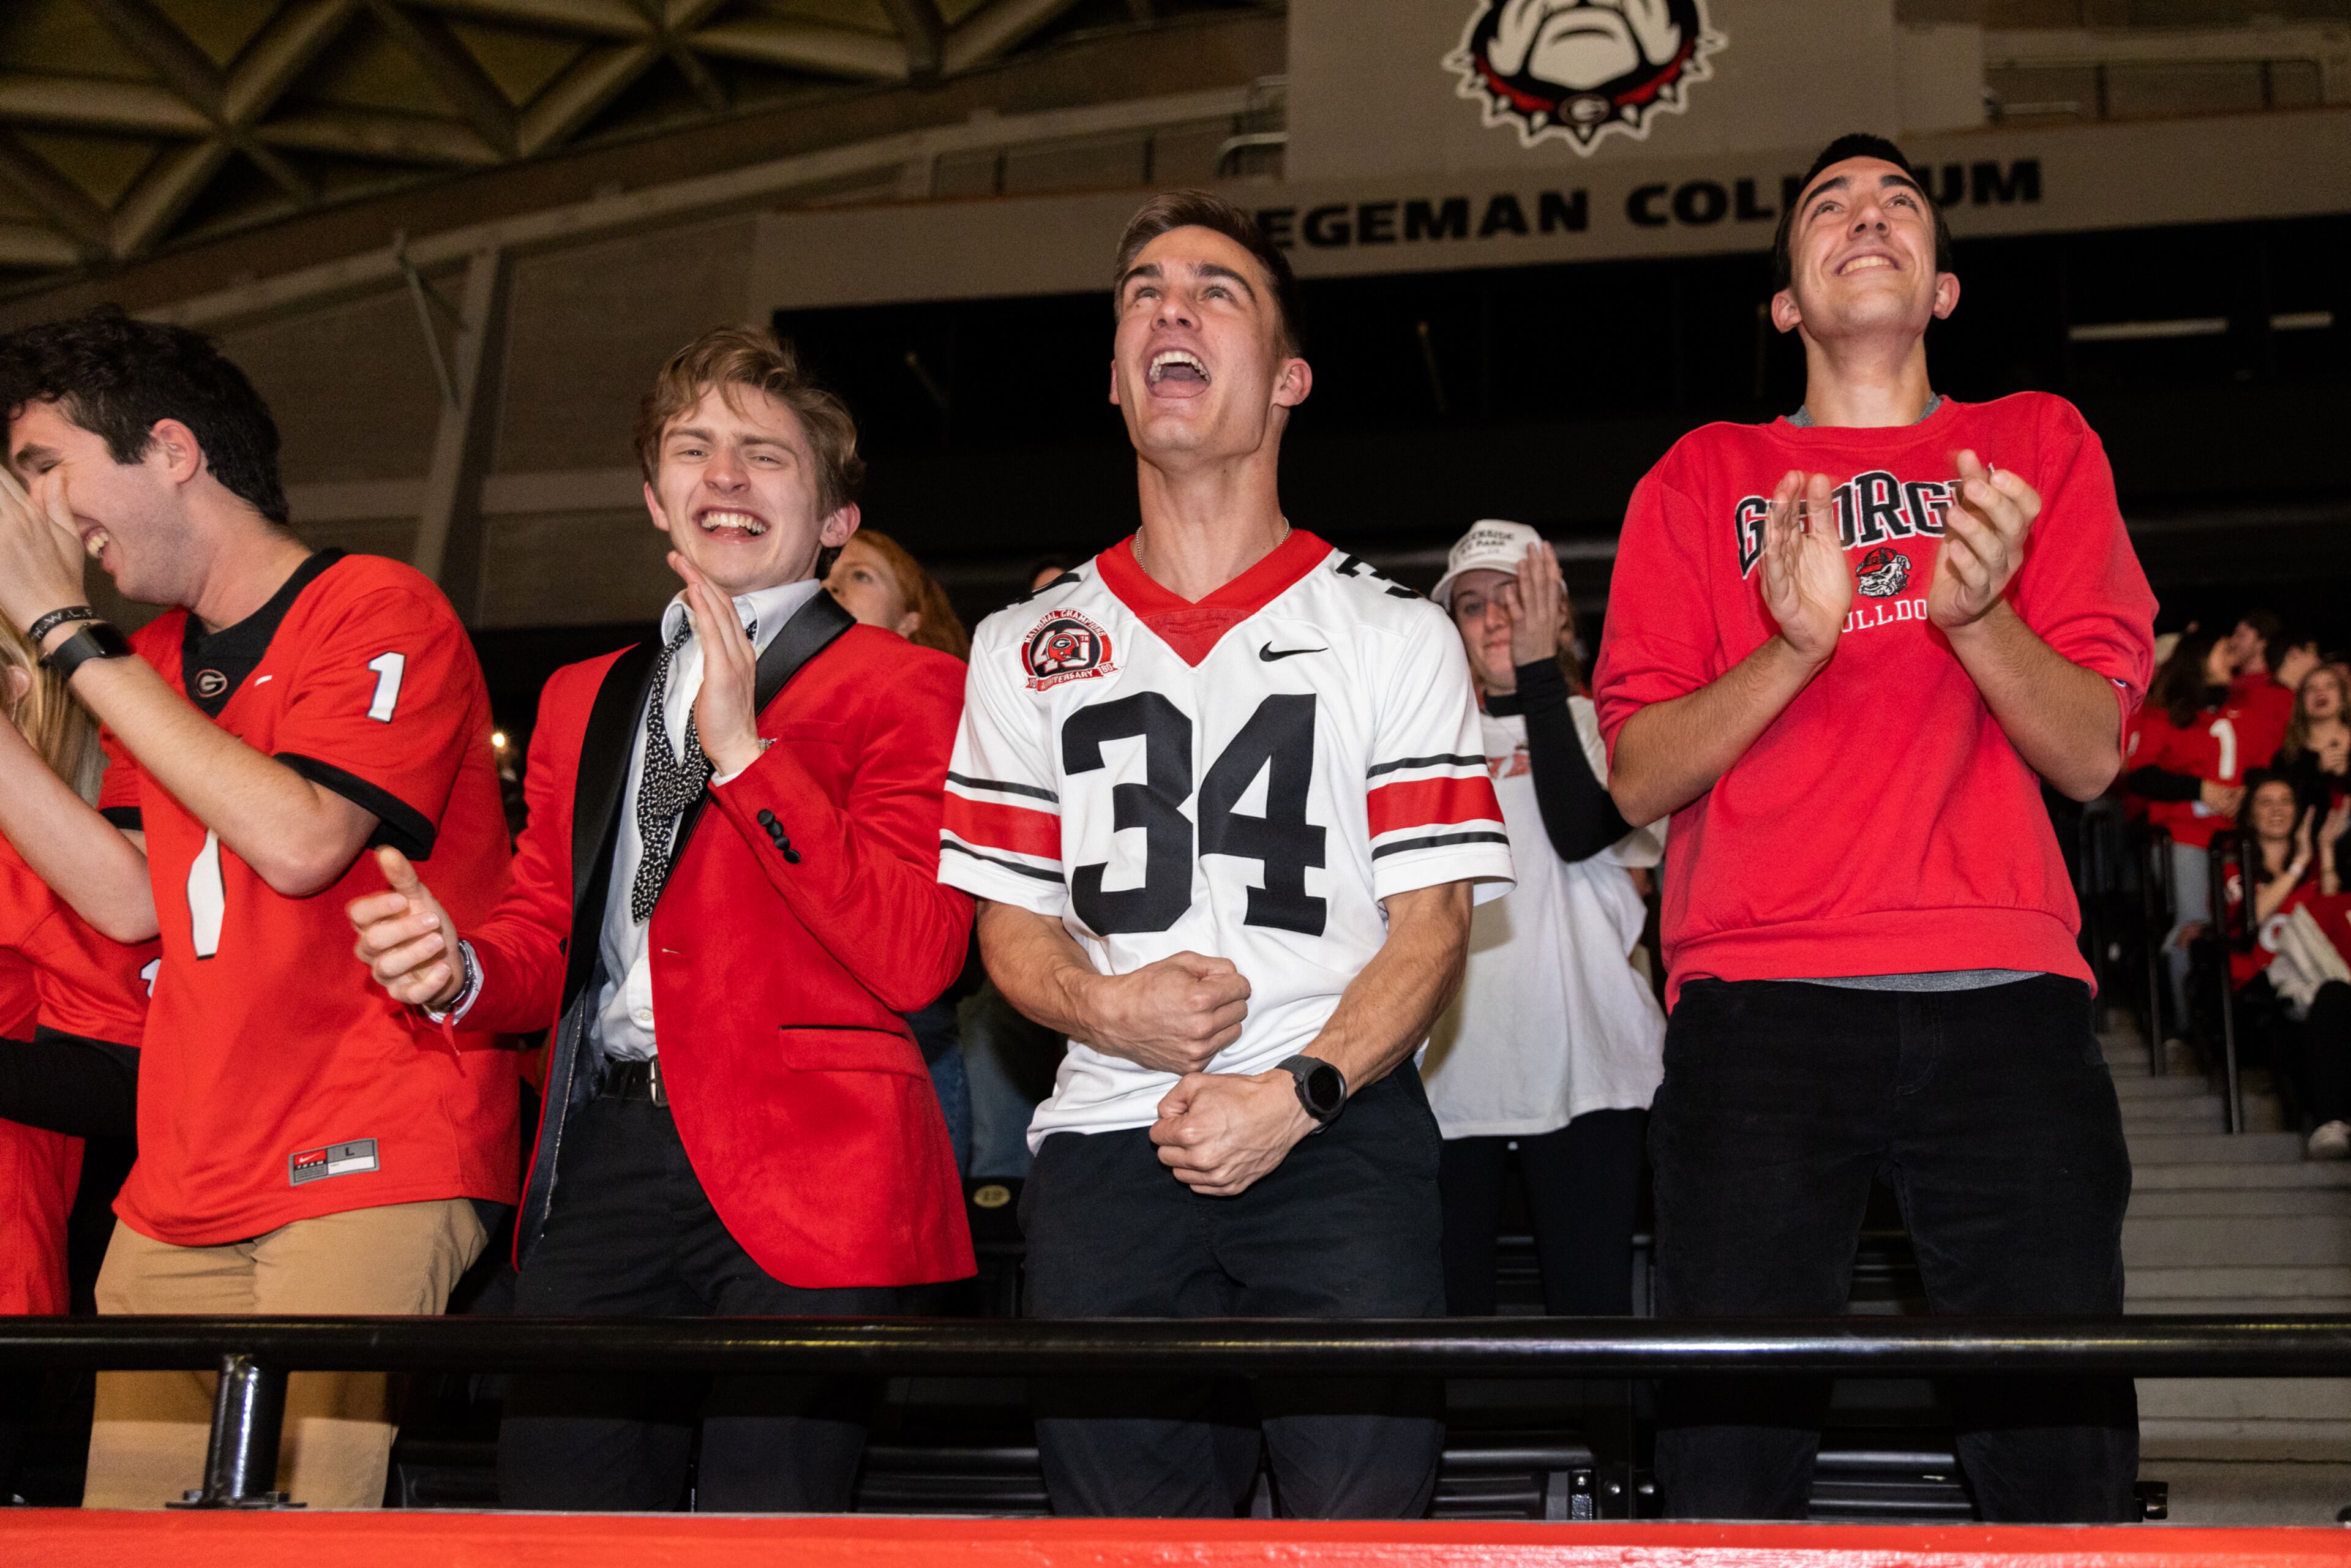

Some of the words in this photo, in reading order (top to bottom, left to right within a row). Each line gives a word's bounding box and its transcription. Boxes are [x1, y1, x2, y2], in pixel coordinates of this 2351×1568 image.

[1257, 190, 1588, 247] EGEMAN
[1024, 611, 1059, 643] NATIONAL
[1060, 609, 1107, 637] CHAMPIONS
[1842, 598, 1929, 633] ULLDO
[367, 651, 406, 723] 1
[1041, 670, 1093, 690] ANNIVERSARY
[2208, 718, 2237, 780] 1
[1061, 691, 1327, 937] 34
[345, 1147, 354, 1157] L
